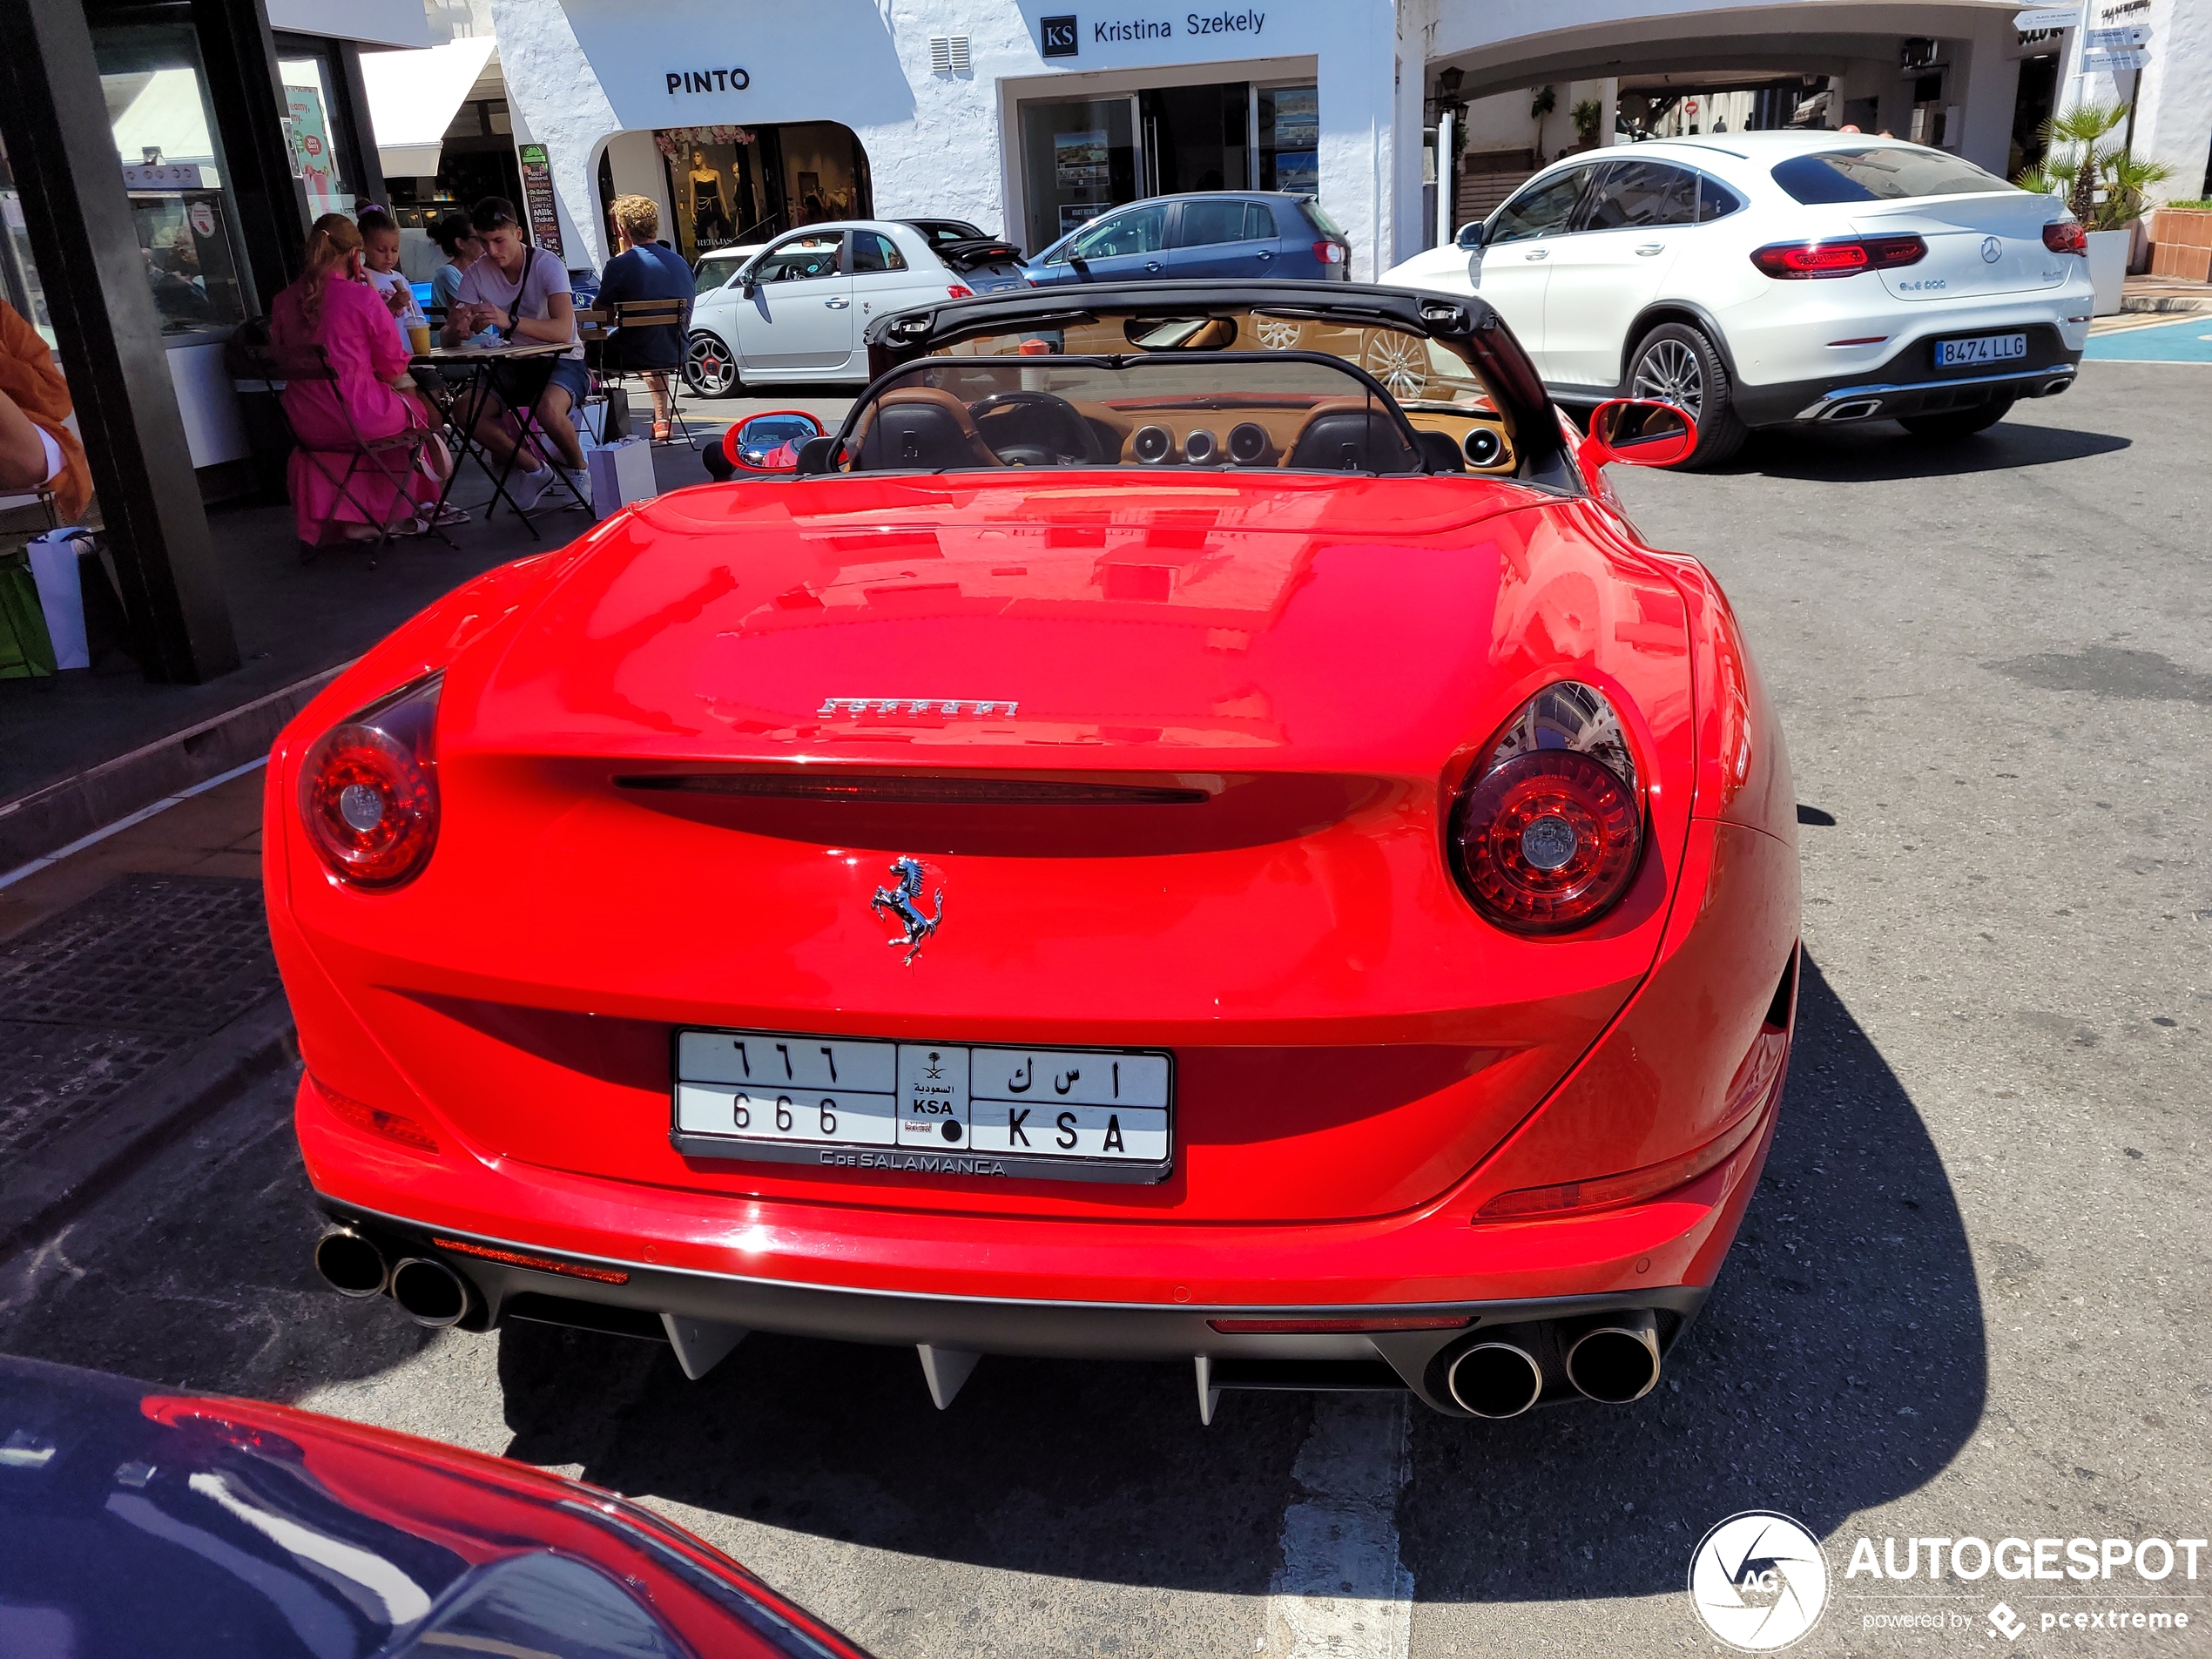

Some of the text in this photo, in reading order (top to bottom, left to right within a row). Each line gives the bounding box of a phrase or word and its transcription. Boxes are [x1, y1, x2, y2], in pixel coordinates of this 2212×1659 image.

[1046, 24, 1074, 47] KS
[1094, 9, 1265, 43] Kristina Szekely
[665, 68, 750, 95] PINTO
[697, 237, 732, 246] REBAJAS
[1946, 337, 2024, 362] 8474 LLG
[914, 1082, 954, 1095] السعودية
[913, 1099, 954, 1115] KSA
[860, 1154, 1008, 1176] SALAMANCA
